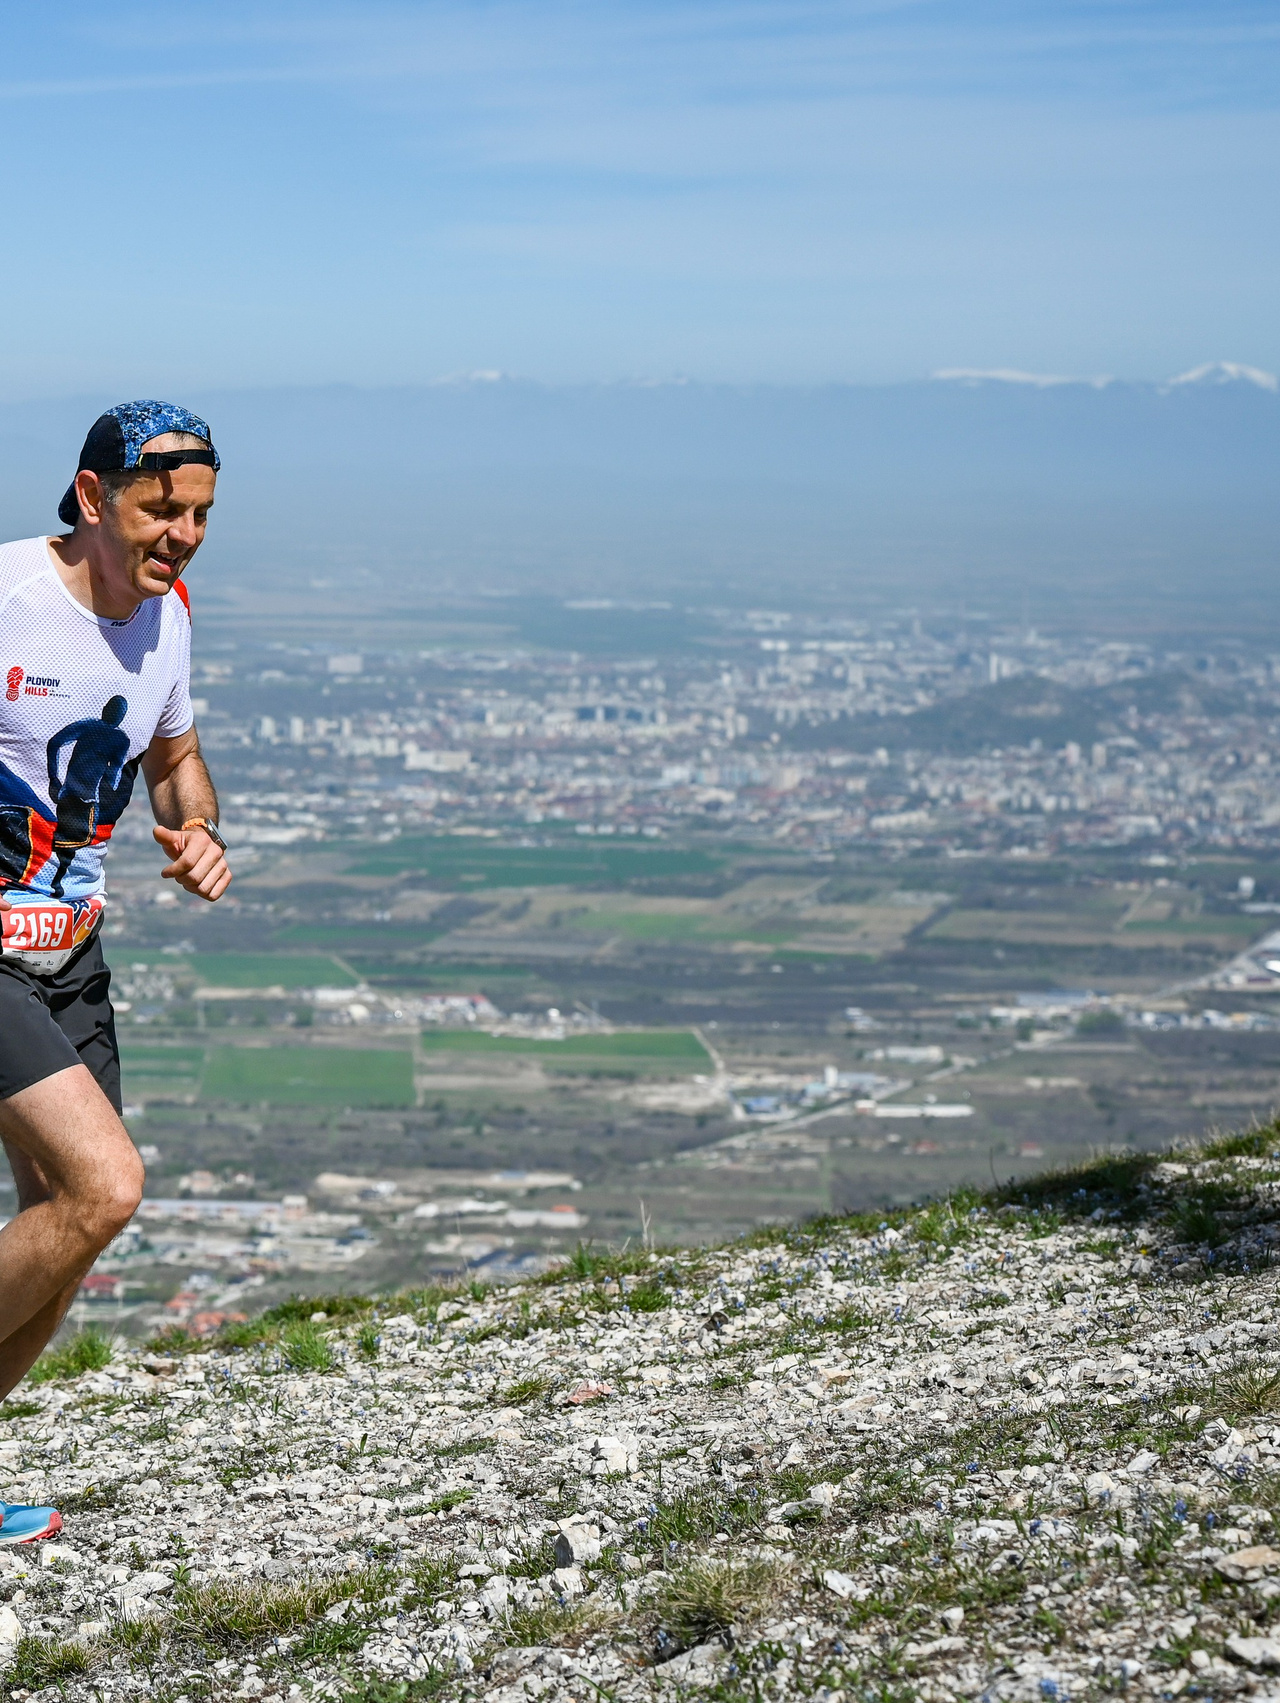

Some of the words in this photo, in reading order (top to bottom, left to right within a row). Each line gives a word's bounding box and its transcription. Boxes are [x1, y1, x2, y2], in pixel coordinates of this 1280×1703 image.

[26, 676, 61, 687] PLOVDIV
[24, 686, 48, 697] HILLS
[8, 912, 68, 947] 2169
